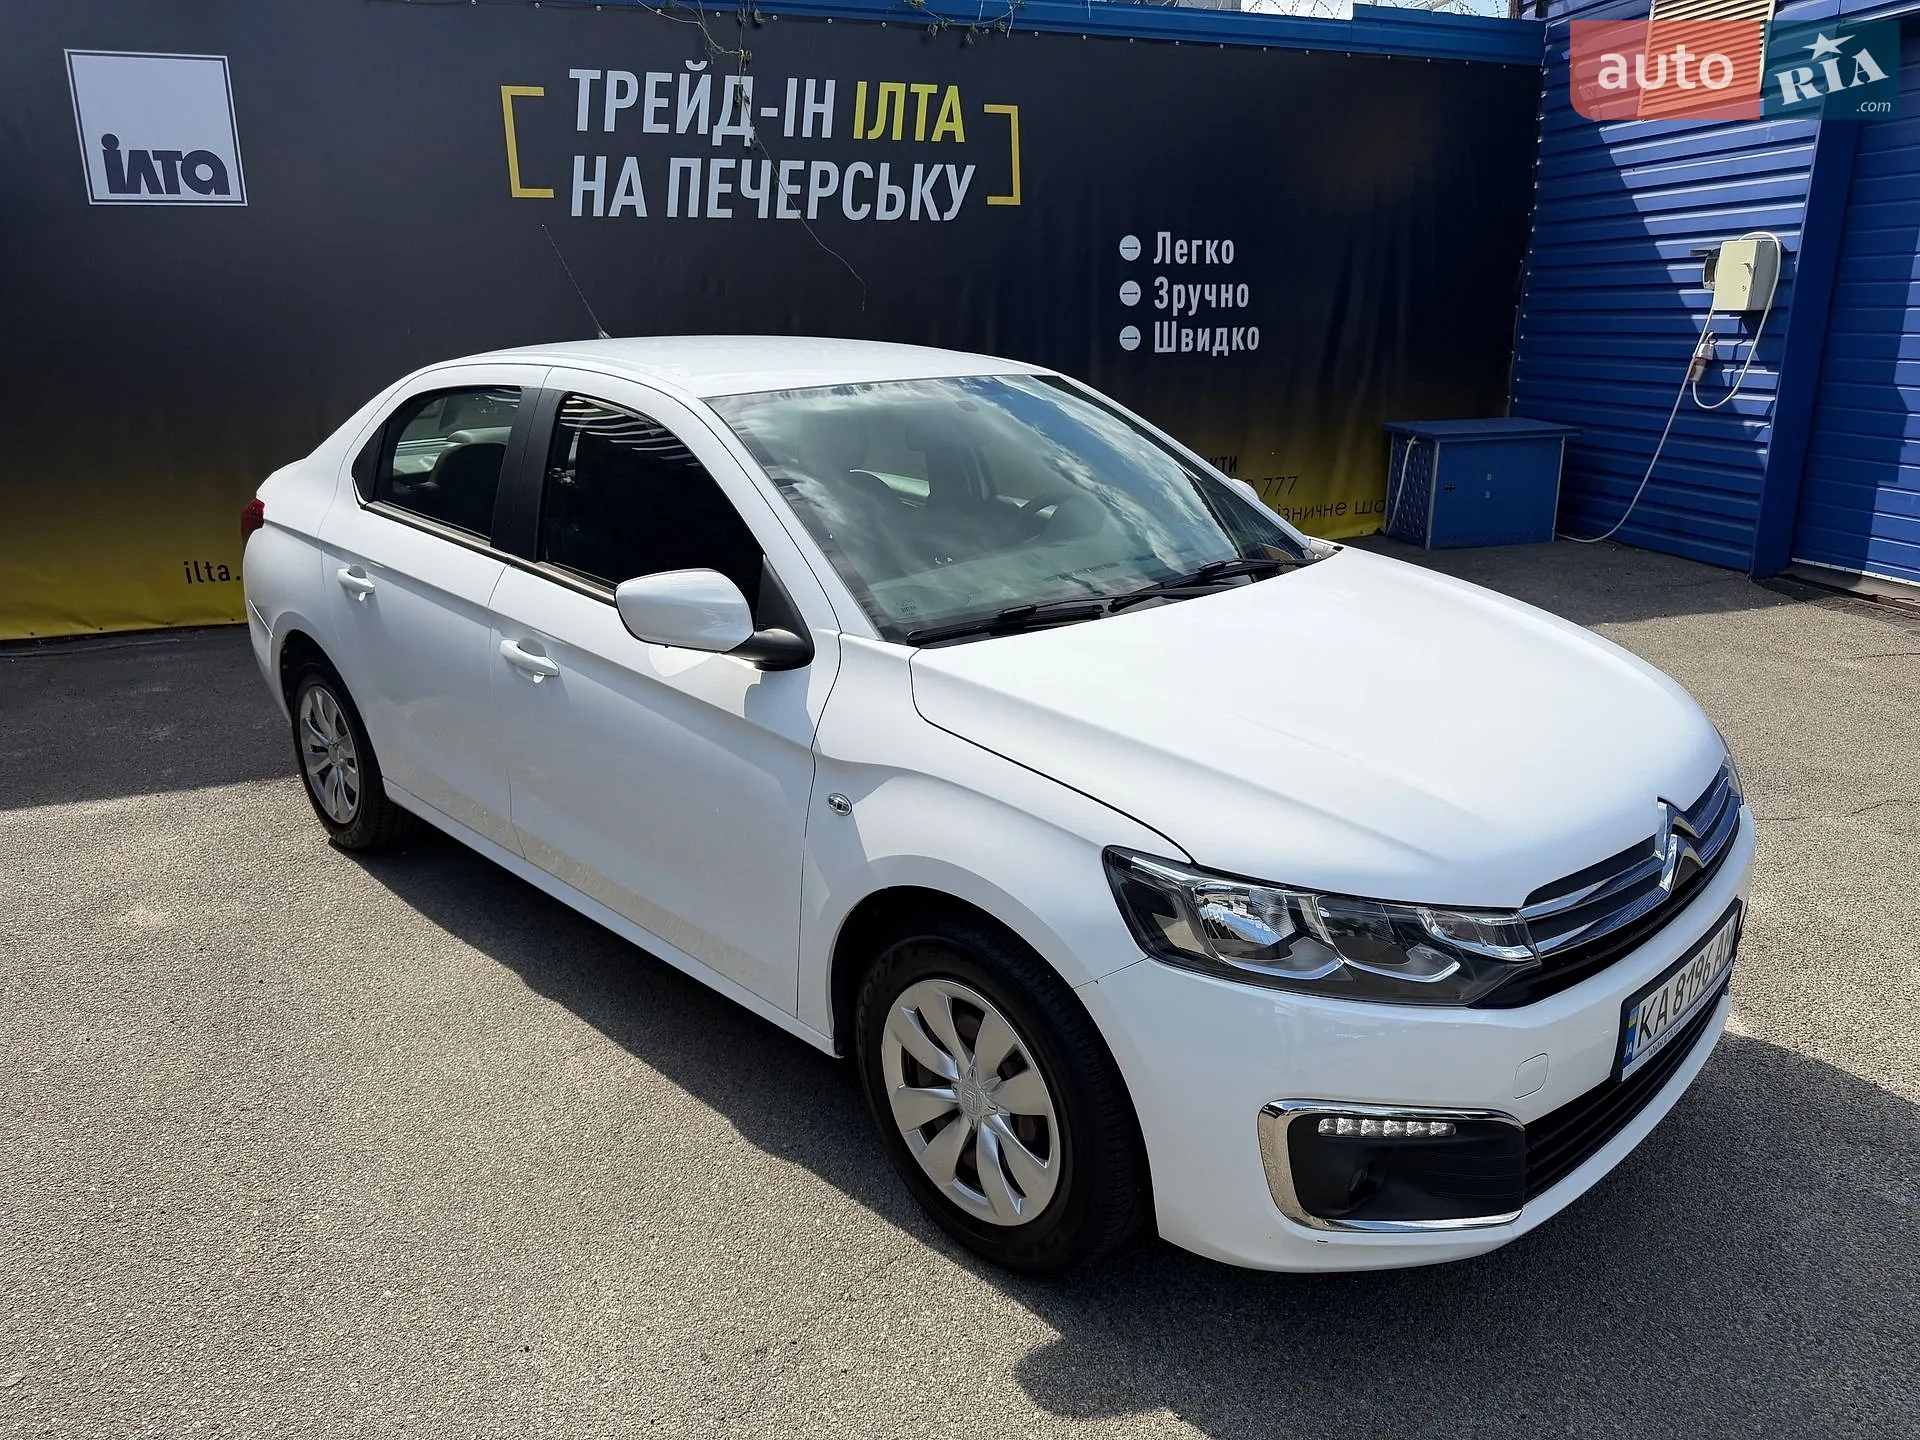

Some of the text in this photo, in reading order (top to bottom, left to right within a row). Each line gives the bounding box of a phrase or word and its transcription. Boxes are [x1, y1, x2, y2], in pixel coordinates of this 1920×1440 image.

[569, 60, 966, 147] ТРЕЙД-ІН ІЛТА
[571, 155, 976, 221] НА ПЕЧЕРСЬКУ
[1153, 231, 1235, 265] Легко
[1153, 276, 1249, 316] Зручно
[1153, 321, 1260, 356] Швидко
[1262, 476, 1298, 498] 777
[183, 560, 241, 584] ilta.
[1636, 986, 1670, 1049] KA
[1672, 943, 1714, 1017] 8196
